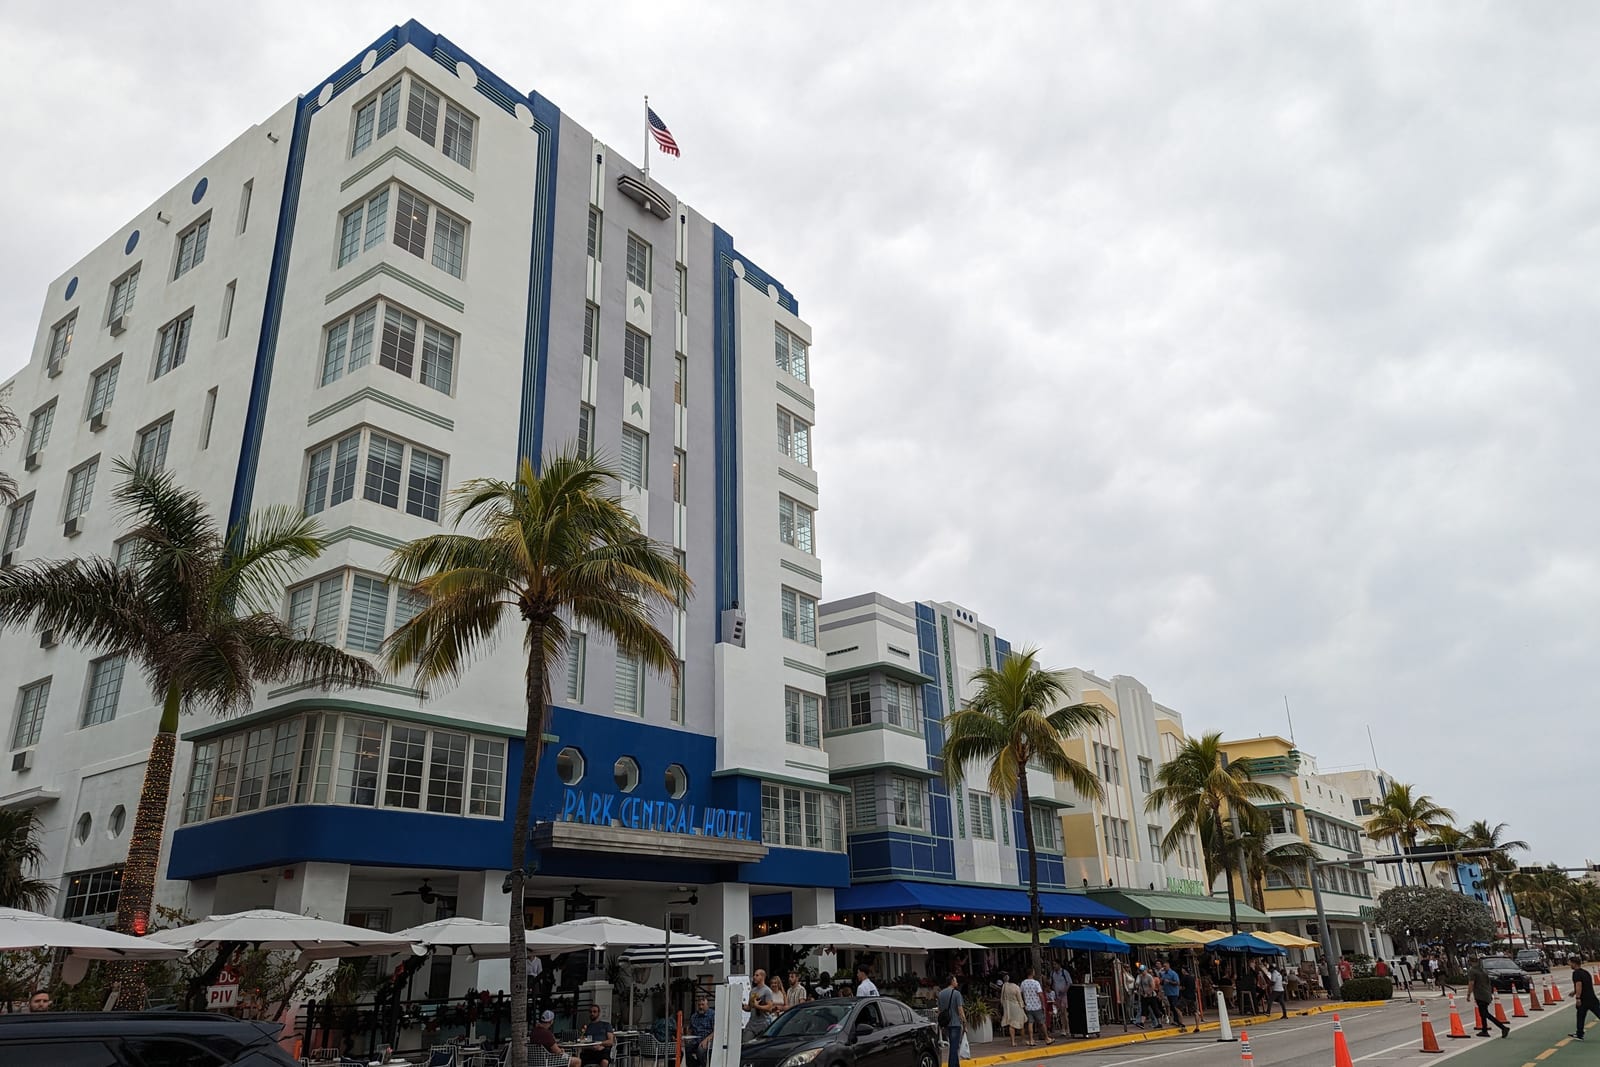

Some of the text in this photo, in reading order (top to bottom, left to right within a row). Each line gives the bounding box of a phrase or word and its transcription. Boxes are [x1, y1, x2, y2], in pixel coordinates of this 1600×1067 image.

[563, 789, 752, 841] PARK CENTRAL HOTEL
[211, 990, 233, 1004] PIV
